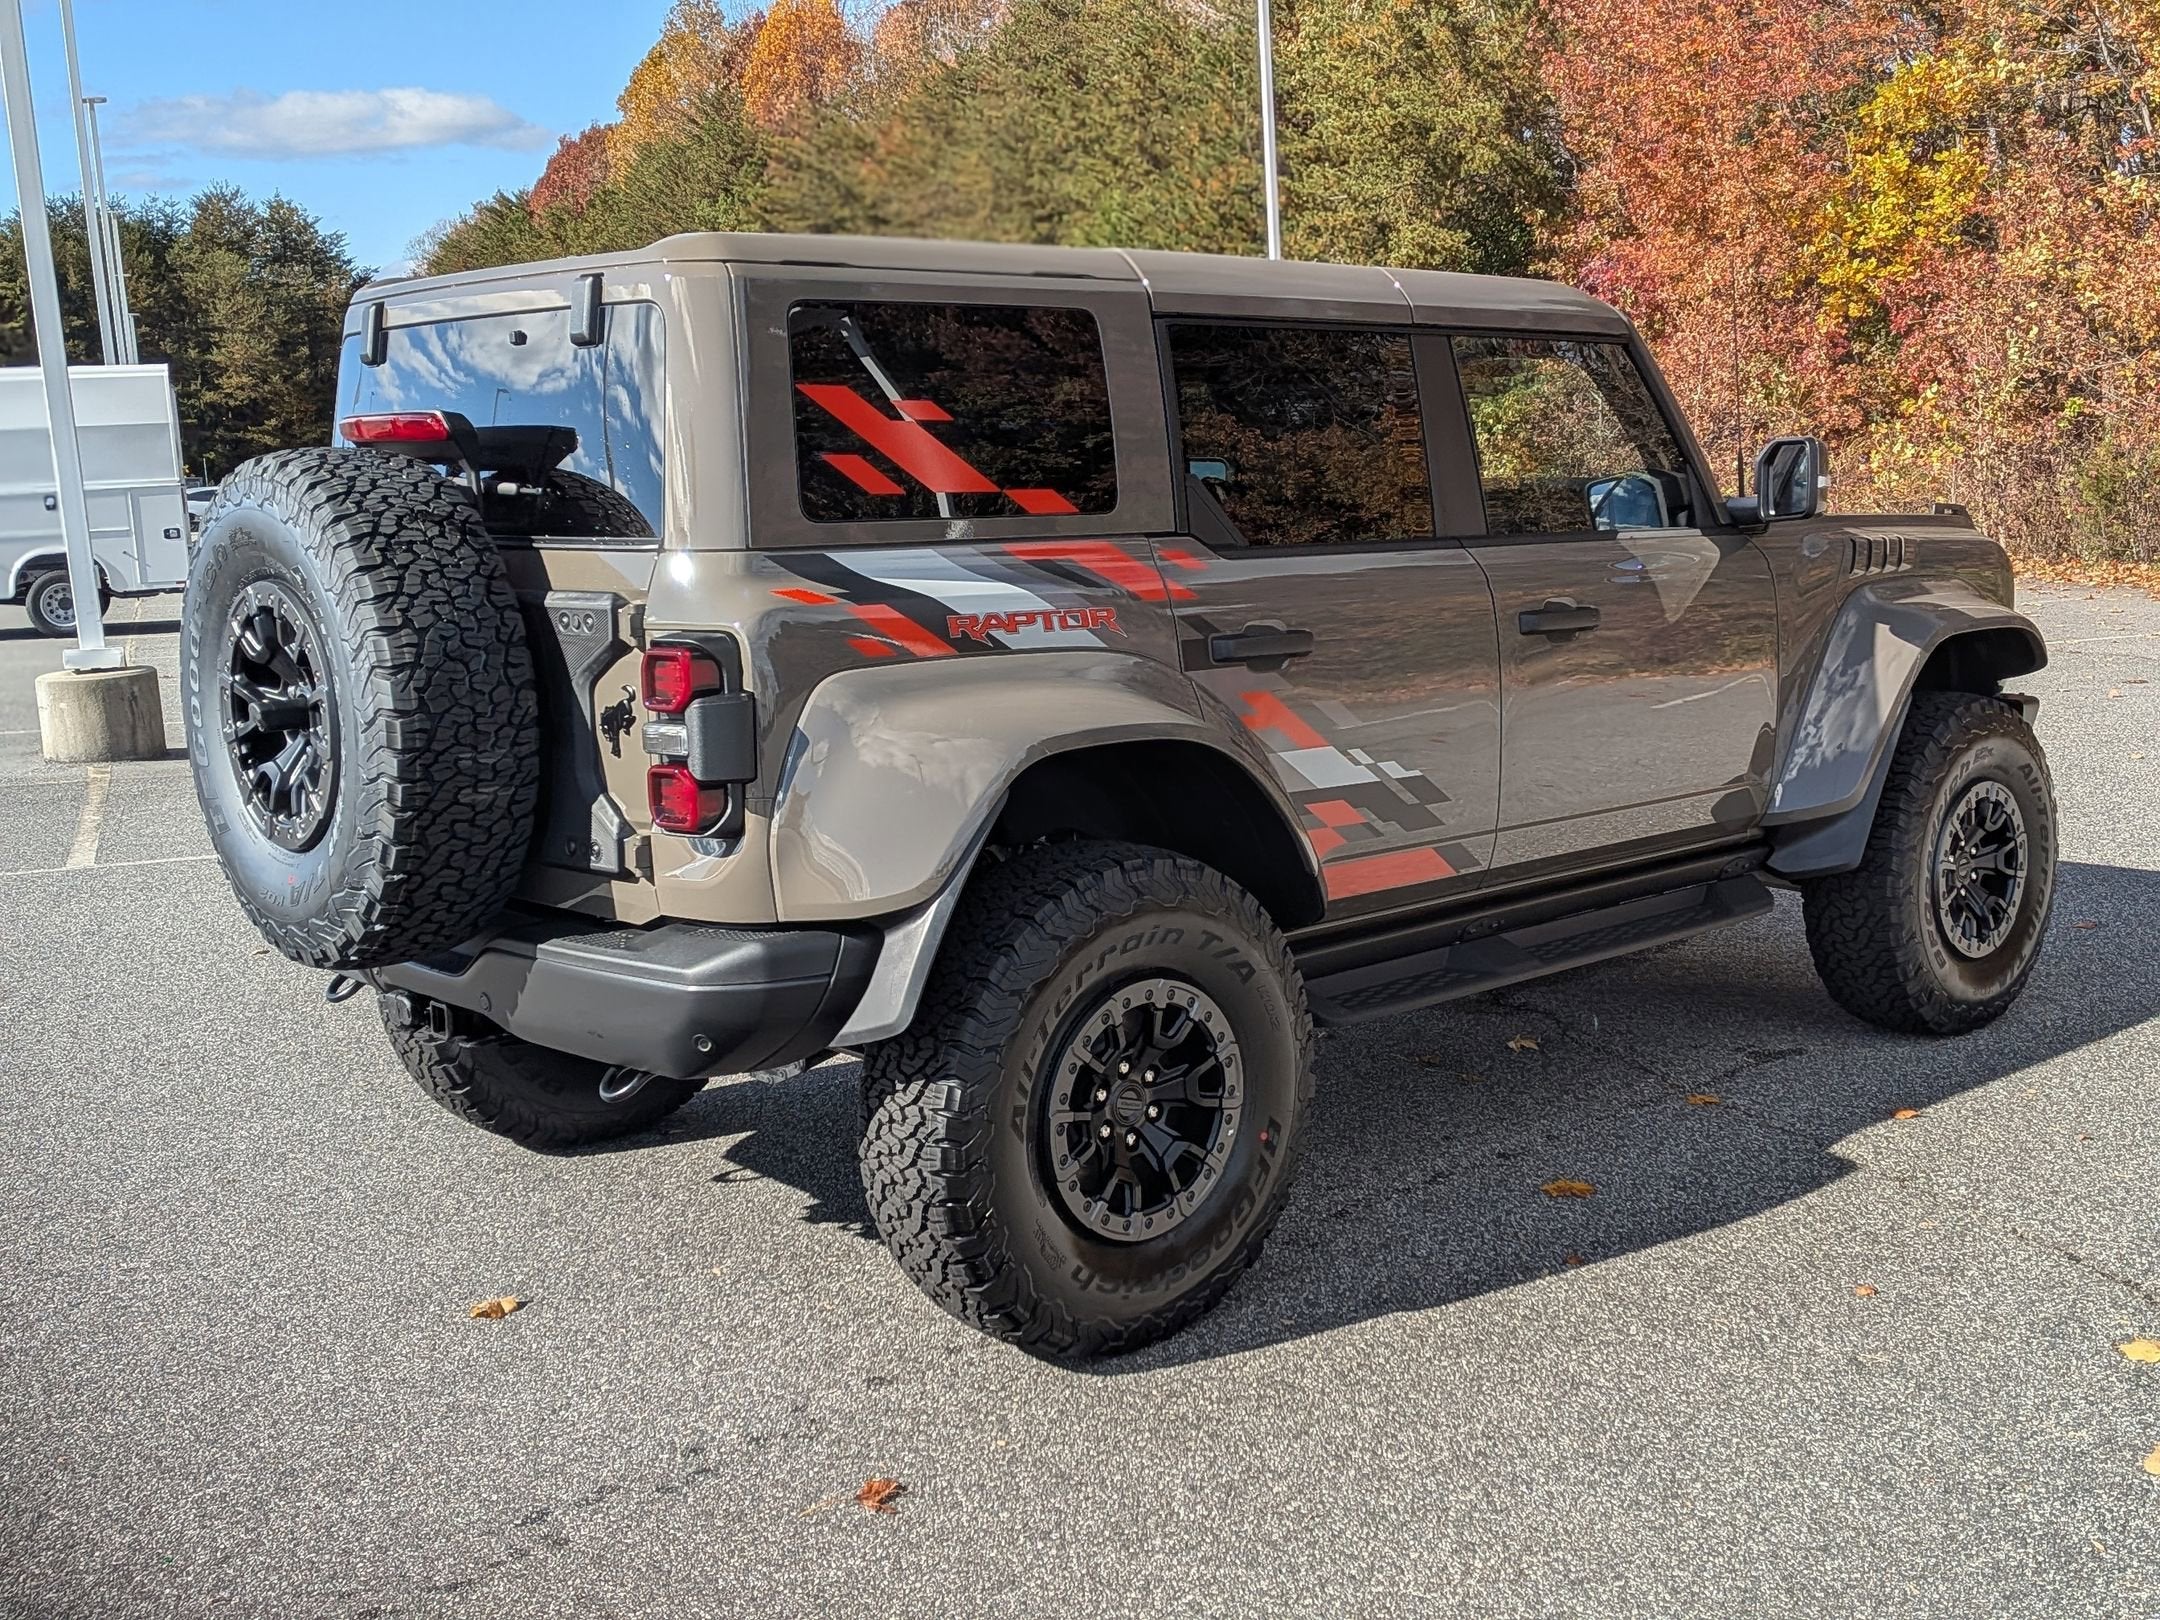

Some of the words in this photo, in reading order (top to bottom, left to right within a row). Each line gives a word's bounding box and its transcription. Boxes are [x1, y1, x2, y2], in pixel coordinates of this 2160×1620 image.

[946, 607, 1128, 647] RAPTOR
[1008, 924, 1183, 1144] All-Terrain
[1196, 929, 1256, 985] T/A
[1070, 1115, 1280, 1298] BFGoodrich
